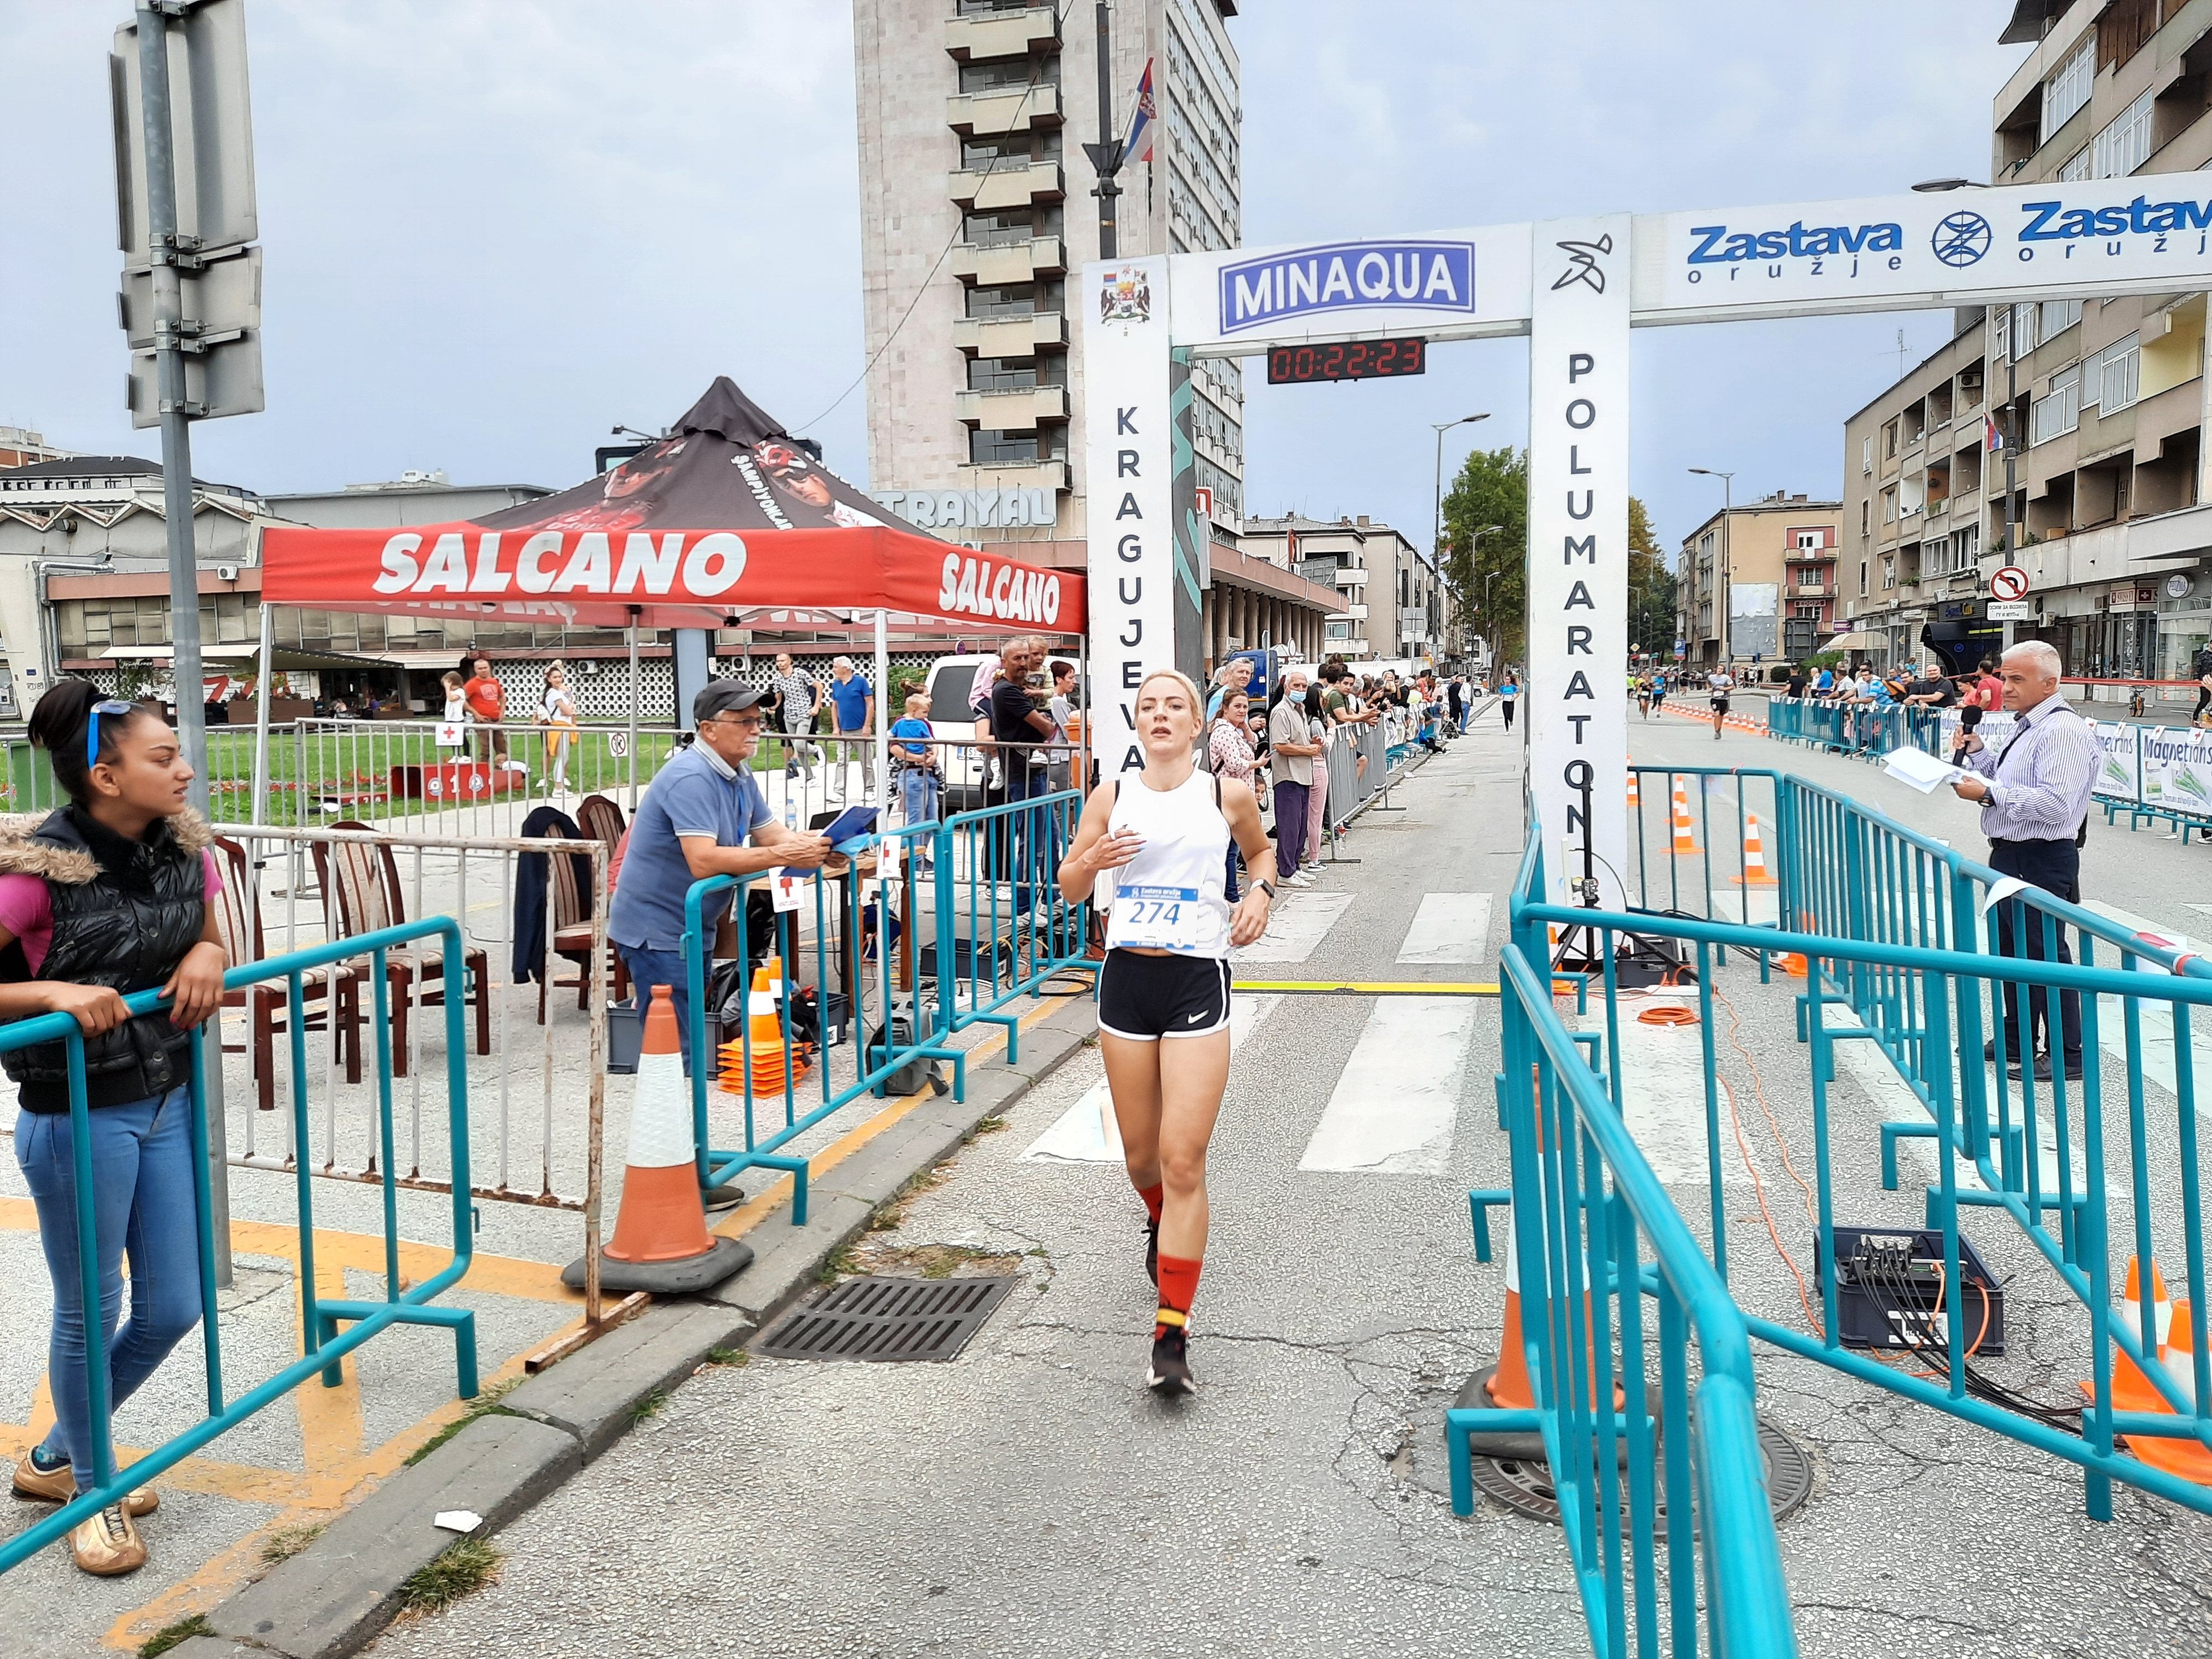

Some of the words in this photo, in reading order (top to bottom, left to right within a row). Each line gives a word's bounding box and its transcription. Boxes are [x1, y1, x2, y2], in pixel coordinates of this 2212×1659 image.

[2018, 195, 2212, 242] Zastav
[1688, 220, 1903, 264] Zastava
[1235, 252, 1458, 321] MINAQUA
[1687, 254, 1902, 284] oružje
[1272, 340, 1421, 381] 00:22:23
[872, 488, 1056, 528] TRAYAL
[372, 532, 748, 597] SALCANO
[938, 552, 1061, 625] SALCANO
[2144, 734, 2212, 768] Magnetrans
[1129, 901, 1181, 926] 274
